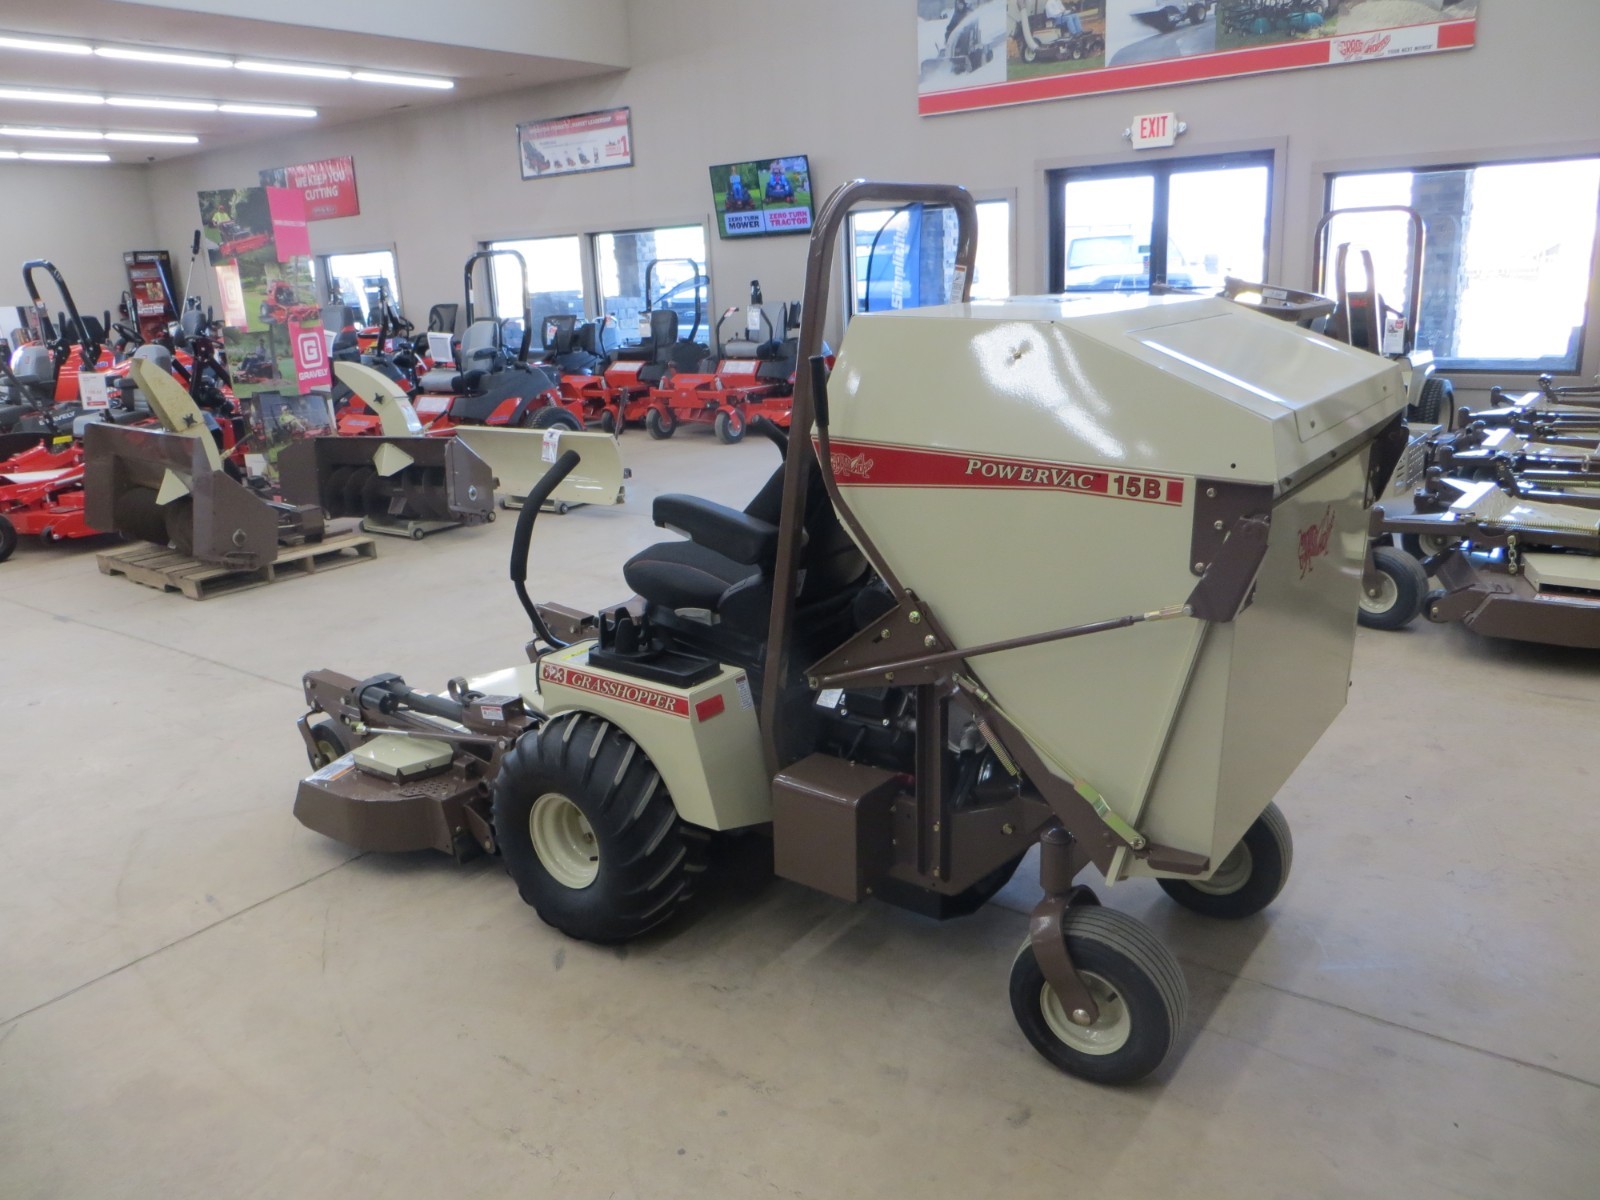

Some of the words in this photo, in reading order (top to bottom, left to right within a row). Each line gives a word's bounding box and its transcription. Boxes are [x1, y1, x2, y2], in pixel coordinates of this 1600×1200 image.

[1140, 116, 1168, 139] EXIT
[295, 176, 308, 188] WE
[308, 172, 328, 187] KEEP
[328, 170, 346, 184] YOU
[304, 185, 339, 201] CUTTING
[728, 221, 760, 230] MOWER
[770, 218, 808, 226] TRACTOR
[298, 367, 329, 381] GRAVELY
[1113, 475, 1162, 500] 15B
[571, 673, 677, 711] GRASSHOPPER
